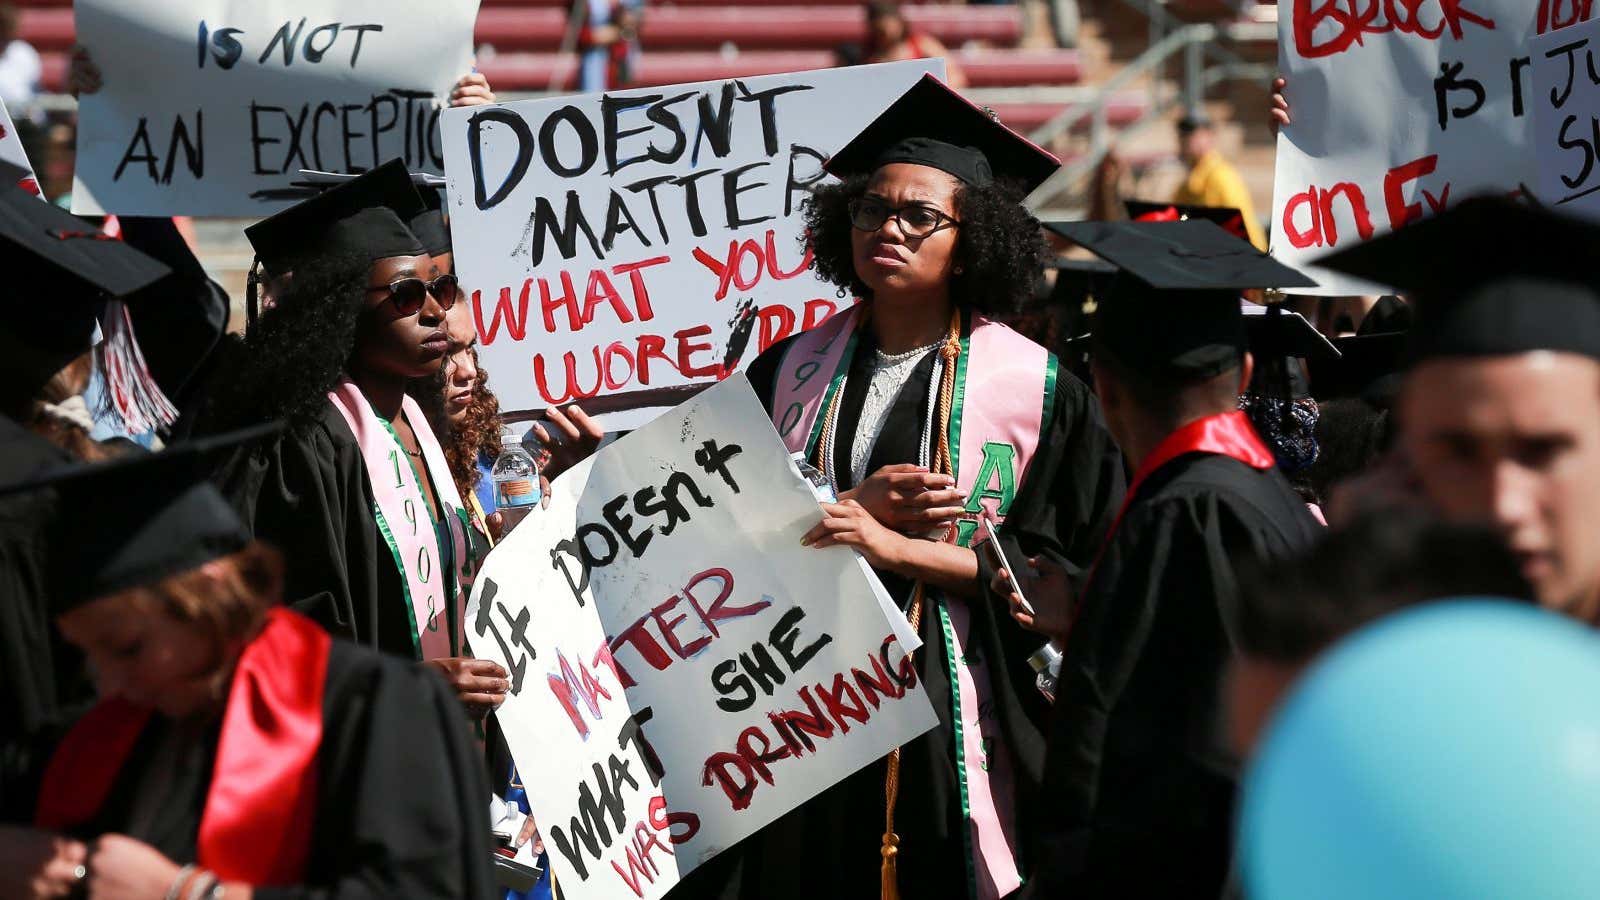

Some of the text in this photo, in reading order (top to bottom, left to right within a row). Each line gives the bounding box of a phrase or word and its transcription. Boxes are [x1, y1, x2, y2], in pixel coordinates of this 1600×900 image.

[198, 18, 383, 70] IS NOT
[113, 105, 204, 184] AN
[1282, 181, 1375, 248] an
[472, 229, 815, 346] WHAT YOU
[387, 449, 438, 633] 1908
[547, 567, 772, 742] MATTER
[550, 606, 833, 881] WHAT SHE
[611, 796, 700, 899] WAS
[702, 633, 917, 811] DRINKING
